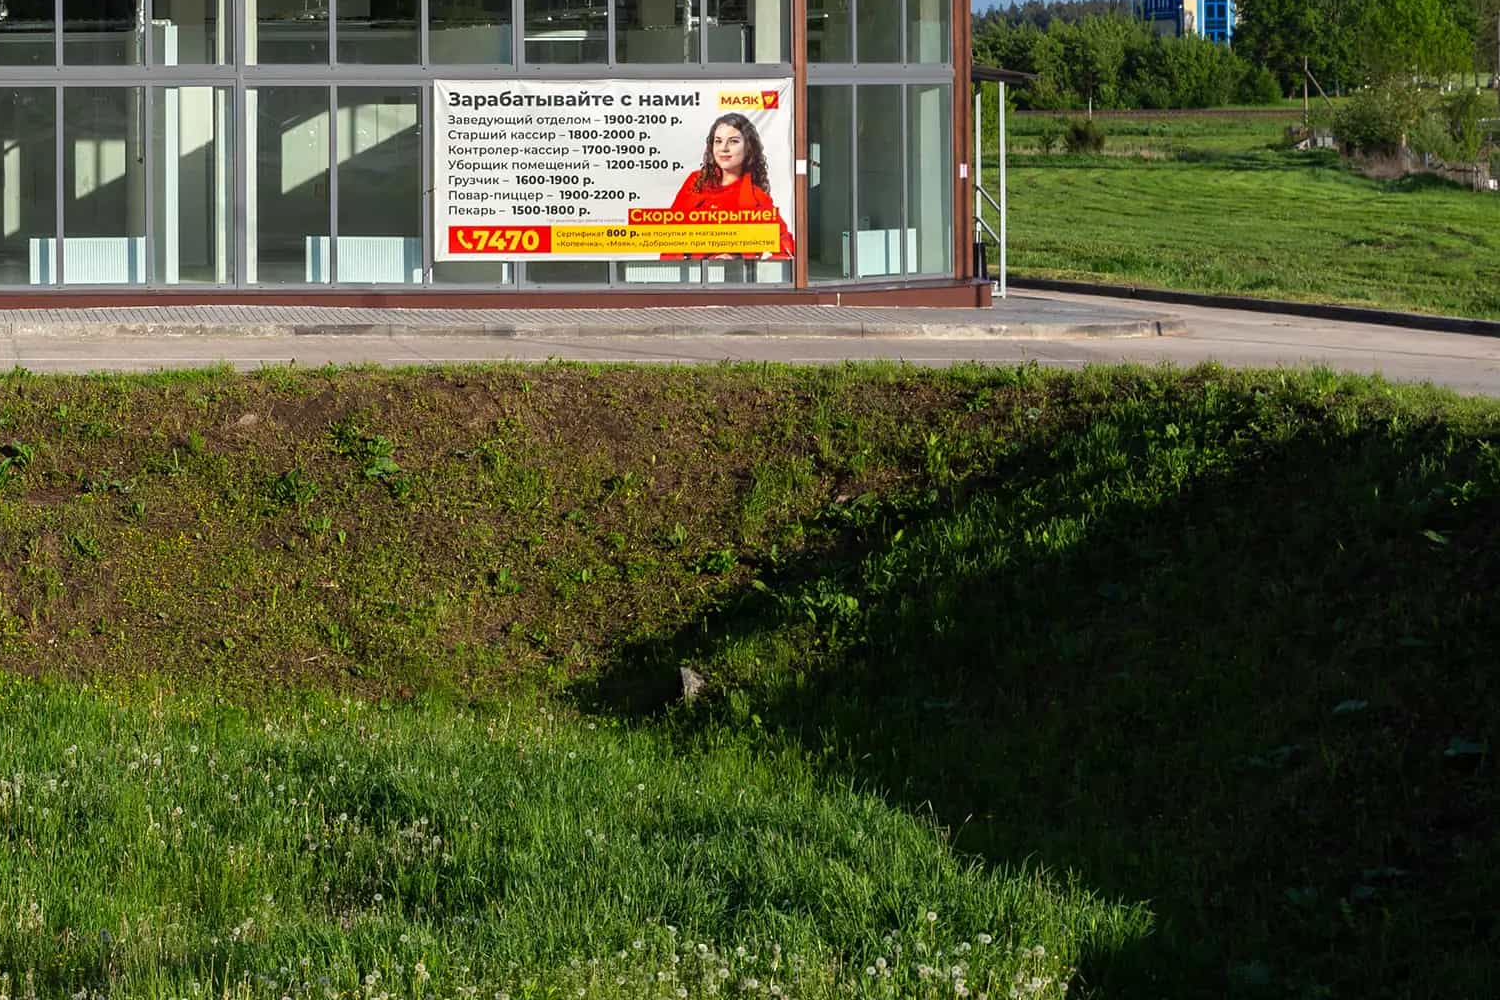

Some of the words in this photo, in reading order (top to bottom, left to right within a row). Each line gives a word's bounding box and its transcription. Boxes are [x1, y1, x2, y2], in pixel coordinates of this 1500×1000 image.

[448, 90, 614, 110] Зарабатывайте
[620, 95, 632, 107] с
[638, 92, 700, 107] нами!
[720, 96, 759, 105] МАЯК
[448, 114, 533, 127] Заведующий
[536, 116, 591, 126] отделом
[603, 114, 667, 125] 1900-2100
[670, 117, 683, 127] р.
[448, 129, 507, 142] Старший
[510, 132, 556, 142] кассир
[568, 129, 636, 140] 1800-2000
[638, 132, 651, 142] р.
[448, 145, 570, 157] Контролер-кассир
[581, 144, 646, 155] 1700-1900
[648, 147, 661, 157] р.
[448, 159, 508, 172] Уборщик
[511, 159, 590, 171] помещений
[605, 159, 669, 170] 1200-1500
[672, 162, 684, 172] р.
[448, 175, 500, 187] Грузчик
[515, 175, 580, 186] 1600-1900
[582, 177, 595, 187] р.
[448, 190, 544, 202] Повар-пиццер
[559, 190, 625, 200] 1900-2200
[628, 192, 641, 202] р.
[448, 205, 496, 217] Пекарь
[511, 205, 575, 216] 1500-1800
[578, 207, 591, 217] р.
[630, 209, 685, 224] Скоро
[688, 207, 778, 224] открытие!
[472, 229, 540, 251] 7470
[556, 230, 604, 239] Сертификат
[606, 229, 627, 238] 800
[629, 230, 640, 240] р.
[653, 231, 687, 239] покупки
[690, 240, 706, 249] при
